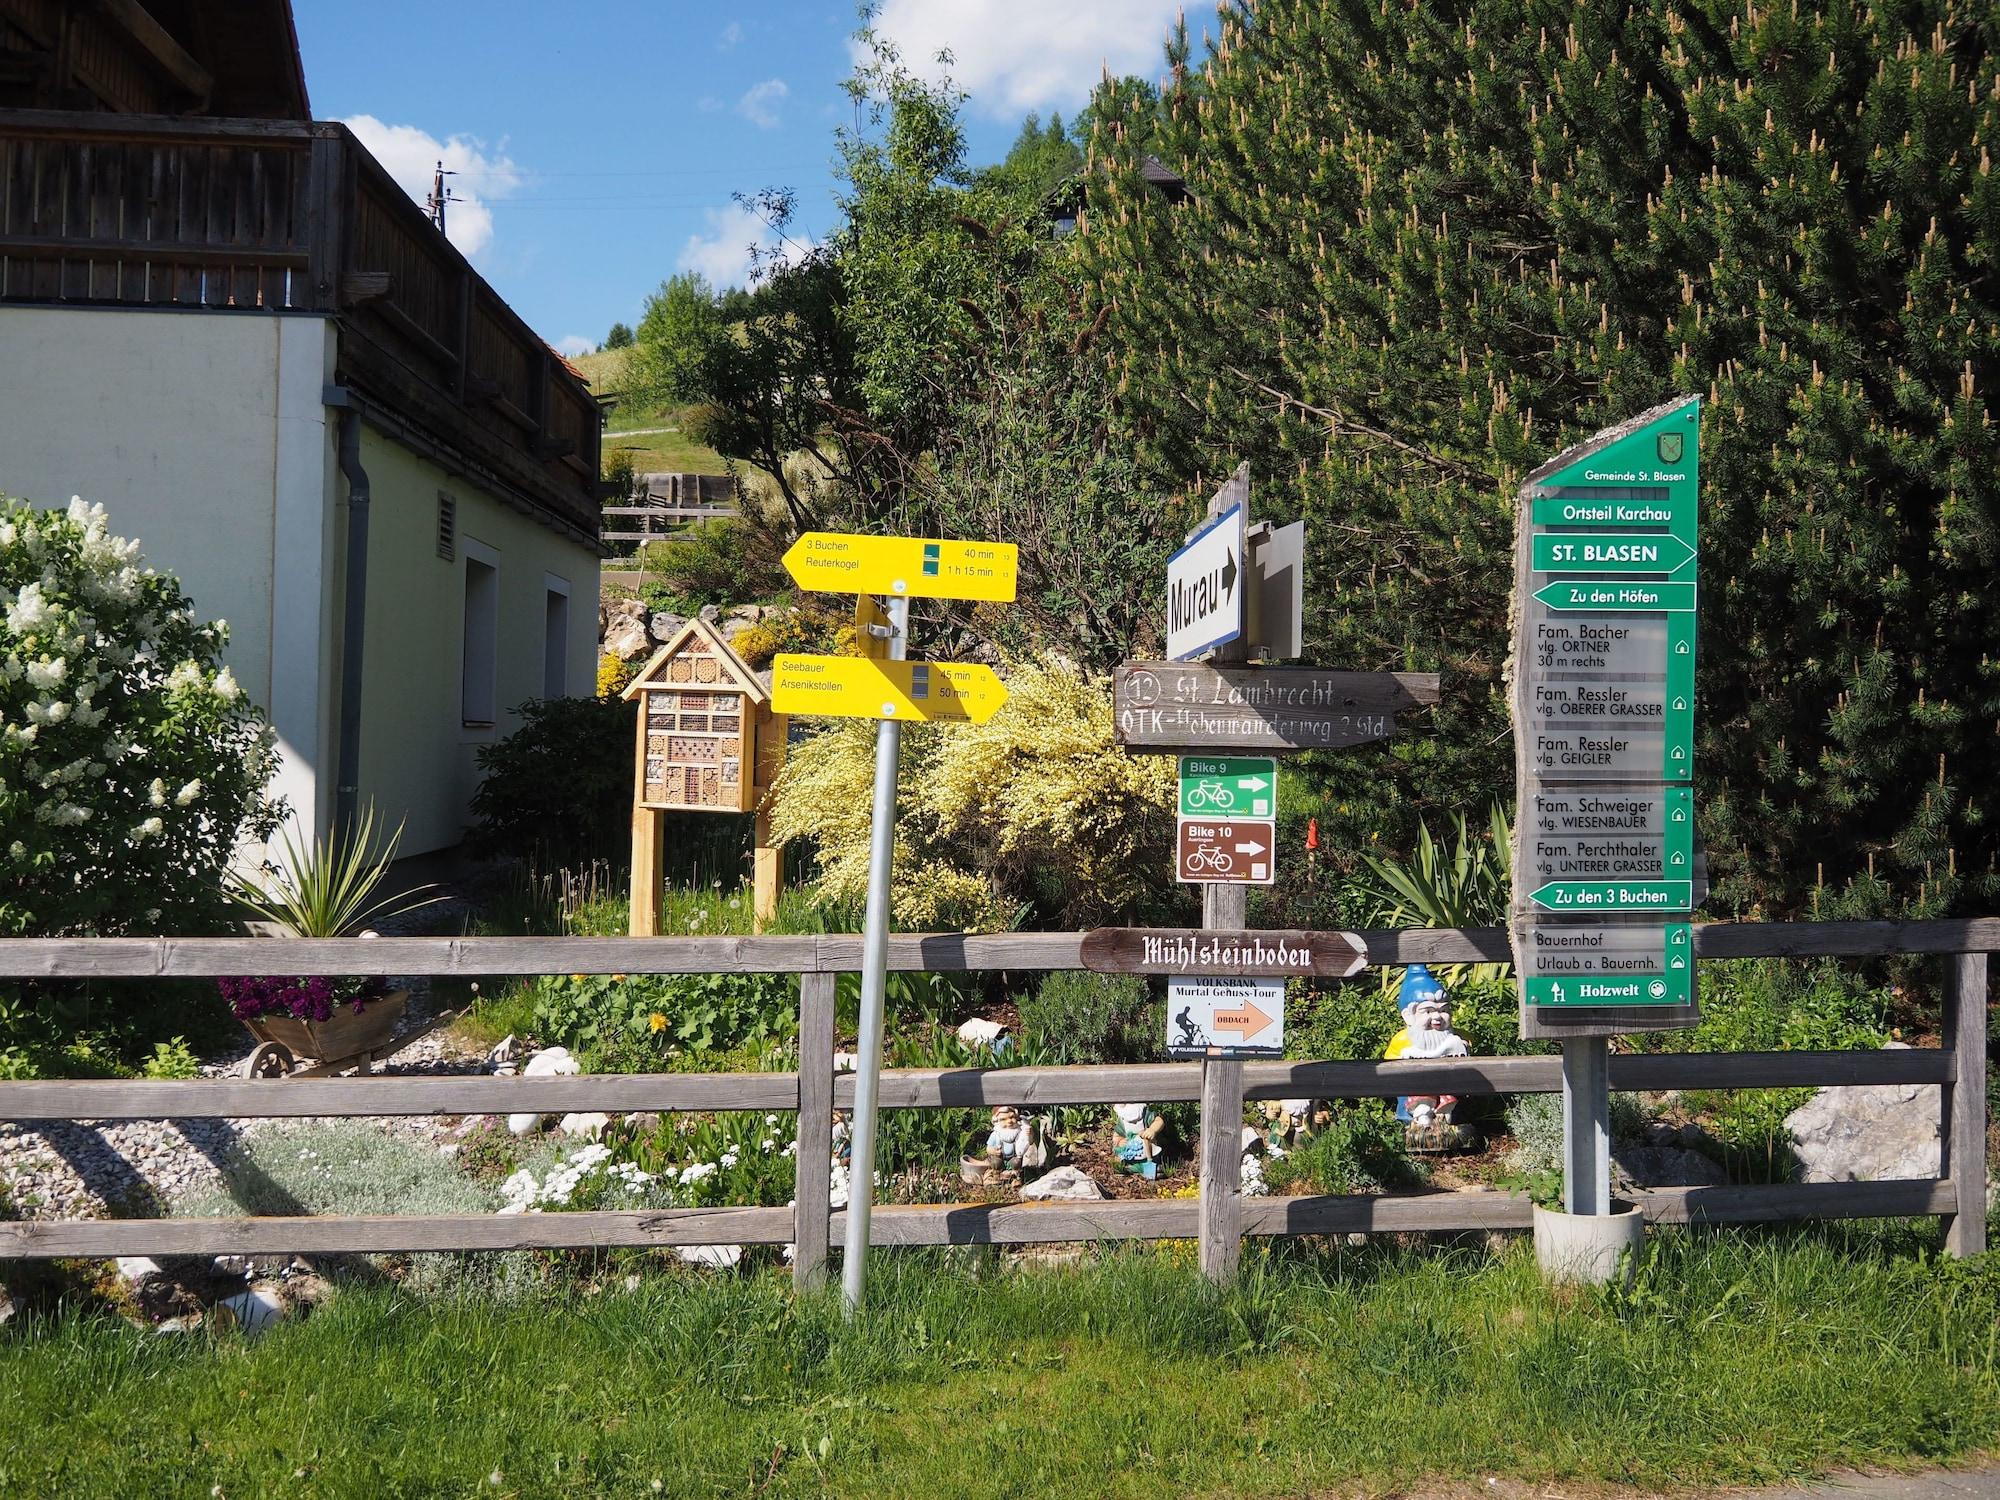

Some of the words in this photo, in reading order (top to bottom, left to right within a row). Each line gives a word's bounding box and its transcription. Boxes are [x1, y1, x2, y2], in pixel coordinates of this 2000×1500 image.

[1585, 470, 1635, 481] Gemeinde
[1639, 472, 1650, 481] St.
[1654, 472, 1686, 481] Blasen
[1563, 505, 1612, 520] Ortsteil
[1616, 506, 1672, 521] Karchau
[806, 540, 812, 549] 3
[815, 540, 849, 550] Buchen
[965, 549, 975, 558] 40
[978, 550, 994, 559] min
[1552, 545, 1576, 561] ST.
[1584, 545, 1657, 562] BLASEN
[806, 557, 859, 570] Reuterkogel
[956, 566, 960, 575] h
[965, 567, 975, 576] 15
[978, 568, 993, 577] min
[1171, 568, 1218, 635] Murau
[1570, 589, 1586, 602] Zu
[1591, 590, 1614, 603] den
[1619, 590, 1658, 603] Höfen
[1538, 624, 1573, 639] Fam.
[1580, 624, 1629, 639] Bacher
[1538, 641, 1557, 655] vlg.
[1562, 641, 1610, 653] ORTNER
[782, 661, 825, 672] Seebauer
[1538, 655, 1552, 667] 30
[1557, 658, 1568, 666] m
[1572, 656, 1605, 667] rechts
[940, 670, 951, 679] 45
[954, 671, 970, 680] min
[781, 679, 843, 691] Arsenikstollen
[1130, 678, 1152, 700] 12
[1174, 676, 1203, 703] St.
[1211, 676, 1334, 705] Lambrecht
[940, 688, 950, 697] 50
[954, 689, 969, 698] min
[1537, 686, 1571, 701] Fam.
[1578, 687, 1628, 701] Ressler
[1536, 703, 1556, 717] vlg.
[1561, 703, 1606, 715] OBERER
[1610, 704, 1662, 716] GRASSER
[1538, 736, 1572, 751] Fam.
[1579, 736, 1629, 751] Ressler
[1537, 752, 1556, 766] vlg.
[1561, 753, 1612, 765] GEIGLER
[1190, 762, 1216, 773] Bike
[1220, 763, 1226, 773] 9
[1538, 798, 1572, 812] Fam.
[1579, 798, 1653, 815] Schweiger
[1538, 816, 1558, 830] vlg.
[1562, 816, 1647, 828] WIESENBAUER
[1189, 826, 1215, 837] Bike
[1218, 827, 1232, 837] 10
[1537, 842, 1571, 856] Fam.
[1577, 842, 1656, 856] Perchthaler
[1537, 860, 1555, 874] vlg.
[1560, 860, 1609, 872] UNTERER
[1613, 860, 1662, 872] GRASSER
[1555, 889, 1572, 904] Zu
[1577, 889, 1601, 903] den
[1607, 890, 1615, 903] 3
[1620, 889, 1668, 903] Buchen
[1537, 933, 1603, 946] Bauernhof
[1142, 935, 1312, 971] Mühlsteinboden
[1537, 956, 1580, 969] Urlaub
[1584, 960, 1596, 969] a.
[1602, 956, 1658, 969] Bauernh.
[1196, 978, 1257, 988] VOLKSBANK
[1176, 987, 1209, 997] Murtal
[1213, 988, 1276, 998] Genuss-Tour
[1579, 984, 1639, 997] Holzwelt
